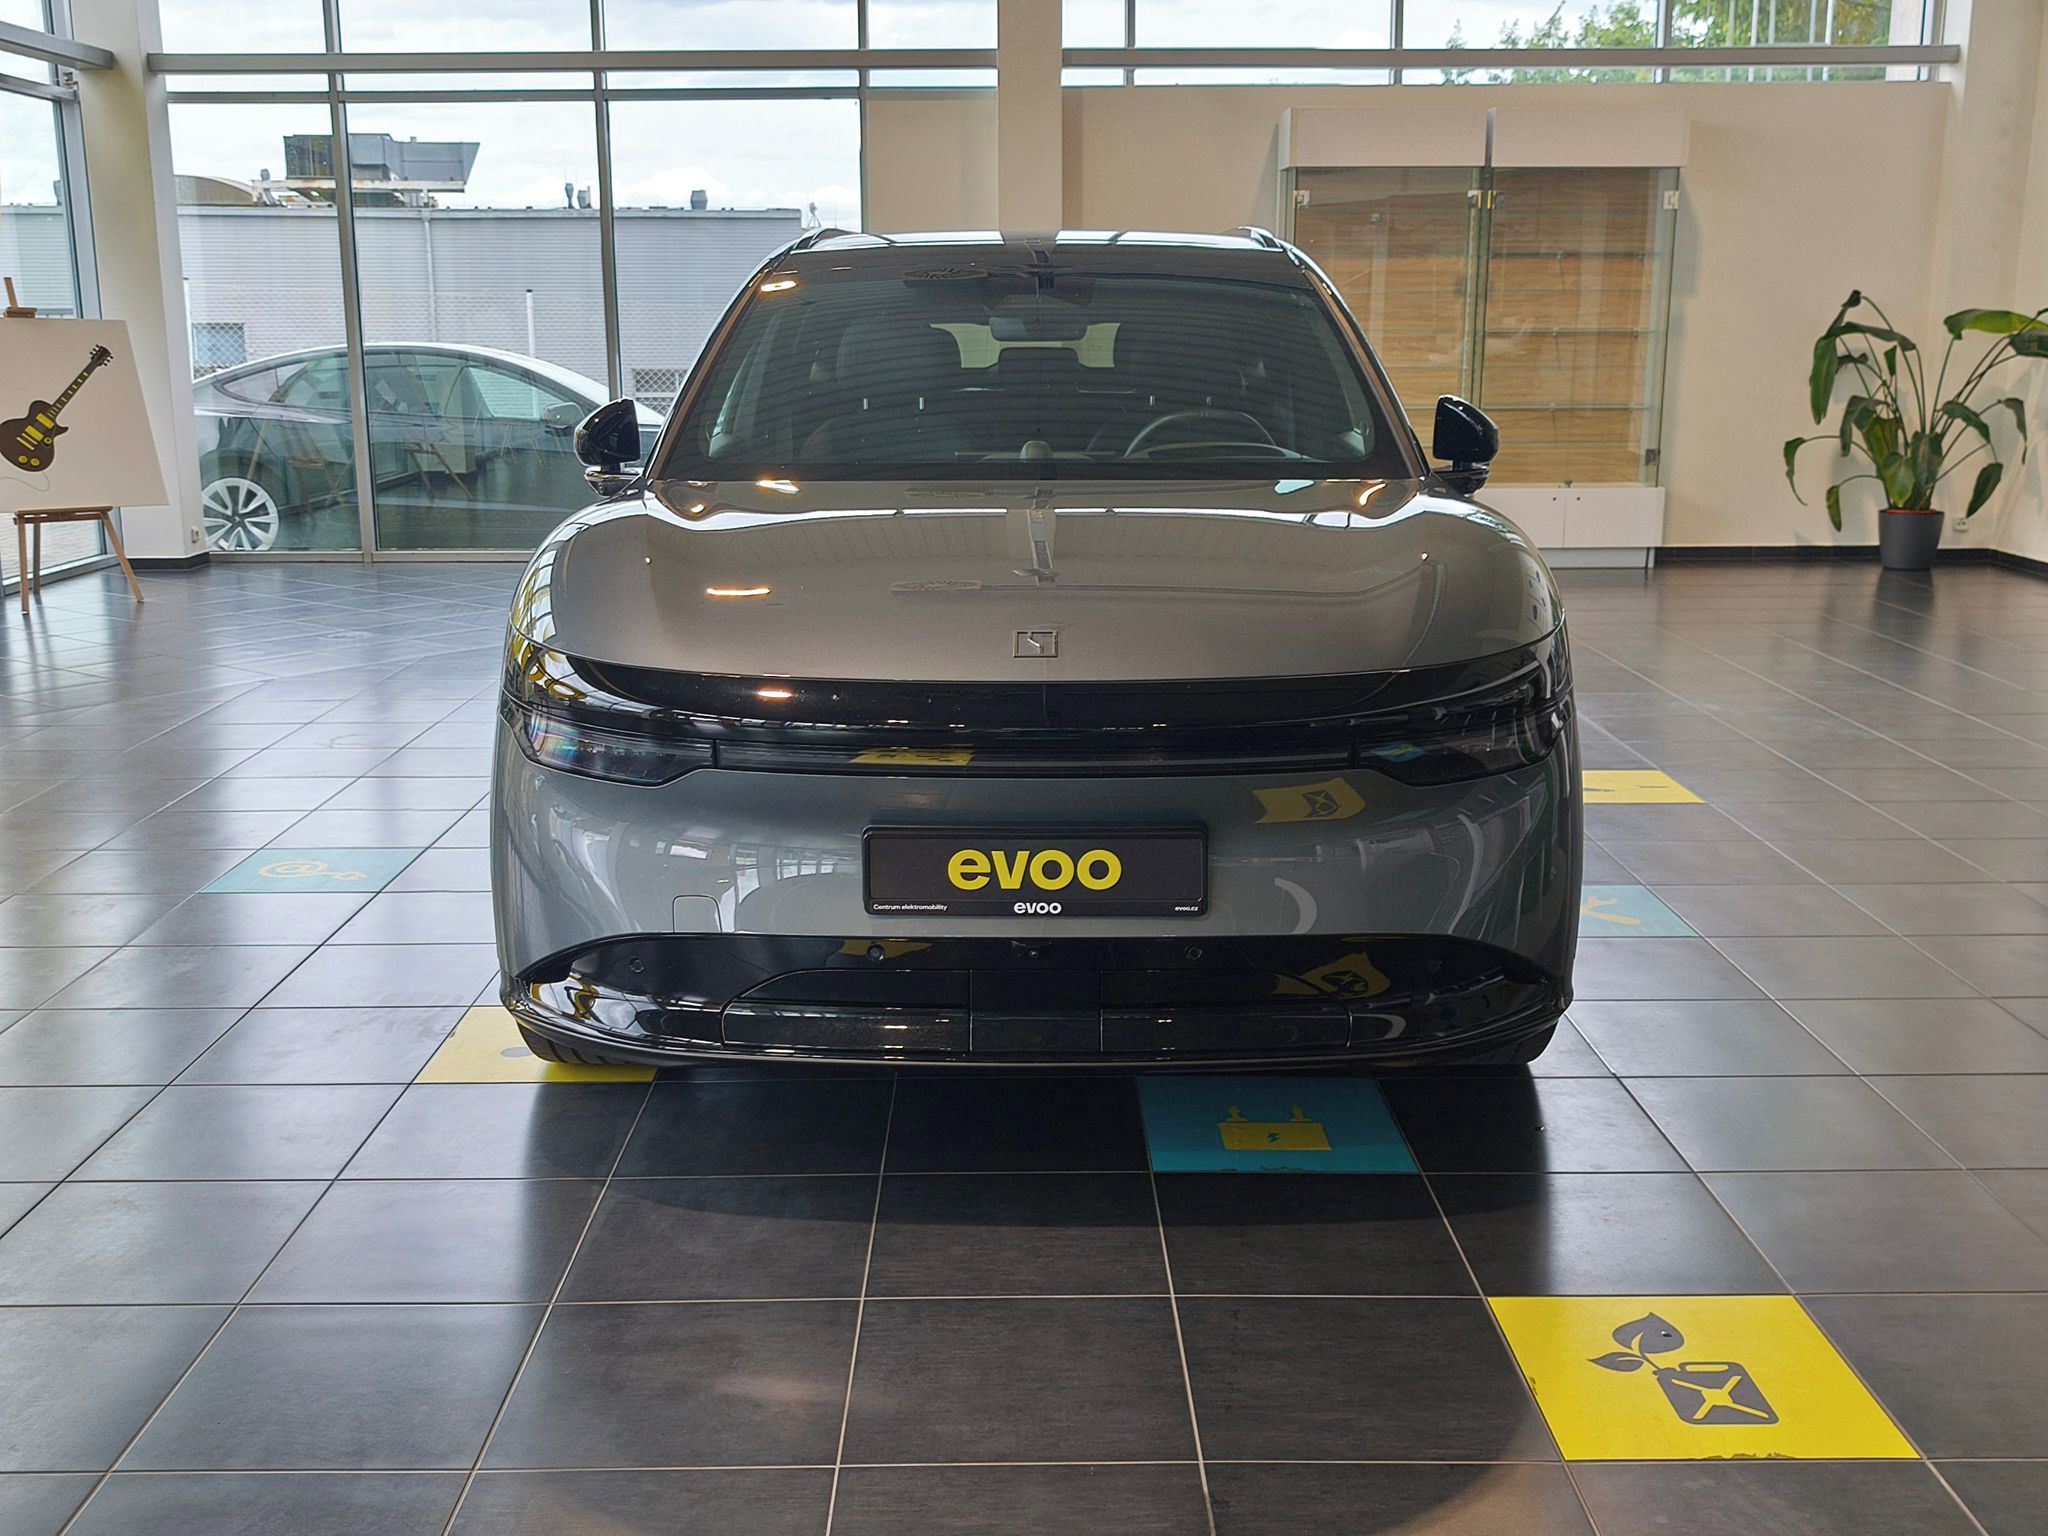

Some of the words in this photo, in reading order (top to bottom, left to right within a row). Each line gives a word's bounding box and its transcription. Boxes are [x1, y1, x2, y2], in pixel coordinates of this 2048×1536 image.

[947, 848, 1122, 891] evoo
[902, 903, 948, 912] elektromobility
[1013, 902, 1062, 914] evoo
